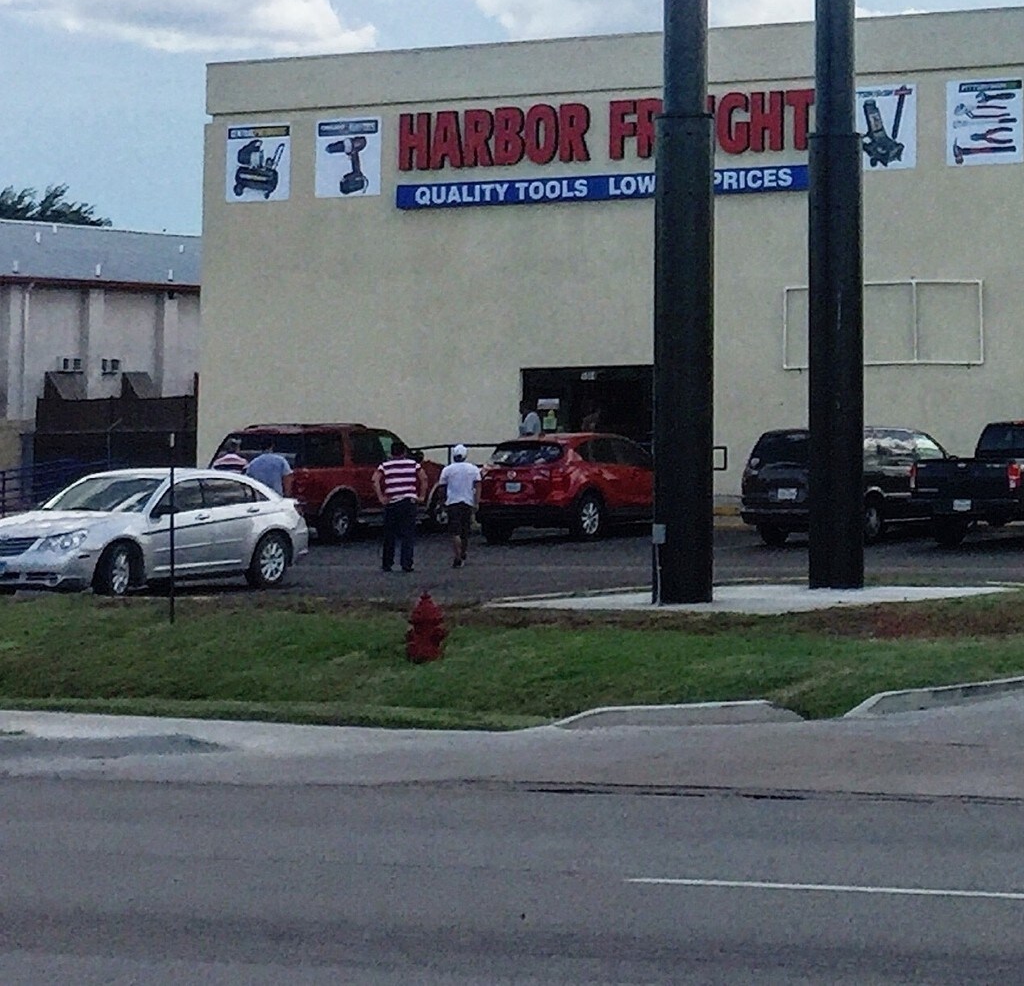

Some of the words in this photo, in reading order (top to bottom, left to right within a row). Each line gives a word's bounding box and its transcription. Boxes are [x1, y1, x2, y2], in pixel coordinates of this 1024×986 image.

[399, 103, 591, 171] HARBOR
[609, 89, 816, 161] FRGHT
[415, 183, 508, 205] QUALITY
[515, 180, 588, 201] TOOLS
